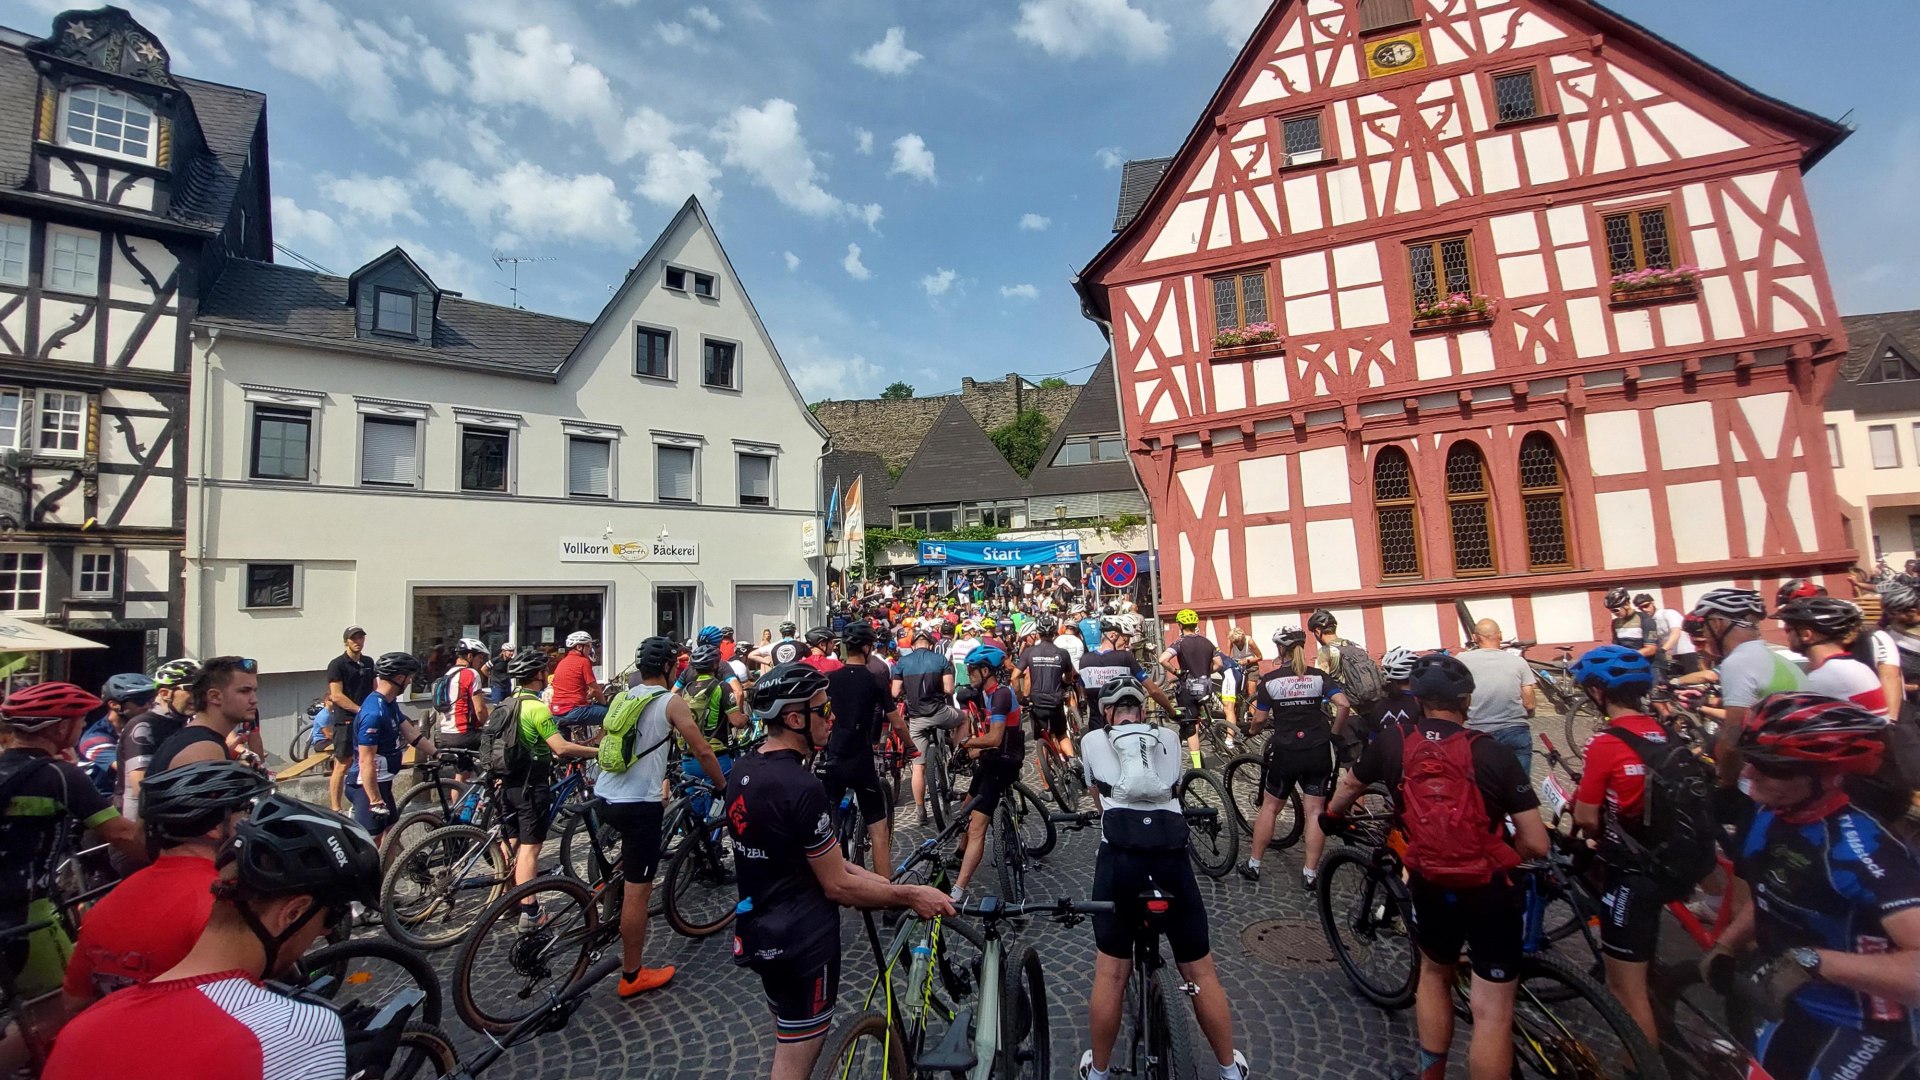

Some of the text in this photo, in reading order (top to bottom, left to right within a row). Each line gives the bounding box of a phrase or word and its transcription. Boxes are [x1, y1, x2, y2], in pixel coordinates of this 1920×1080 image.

[563, 542, 609, 555] Vollkorn
[653, 544, 695, 556] Bäckerei
[983, 546, 1021, 561] Start
[1139, 736, 1149, 769] USWE
[326, 835, 348, 868] uvex
[746, 847, 769, 859] ZELL
[1613, 885, 1631, 928] HENDRIKX
